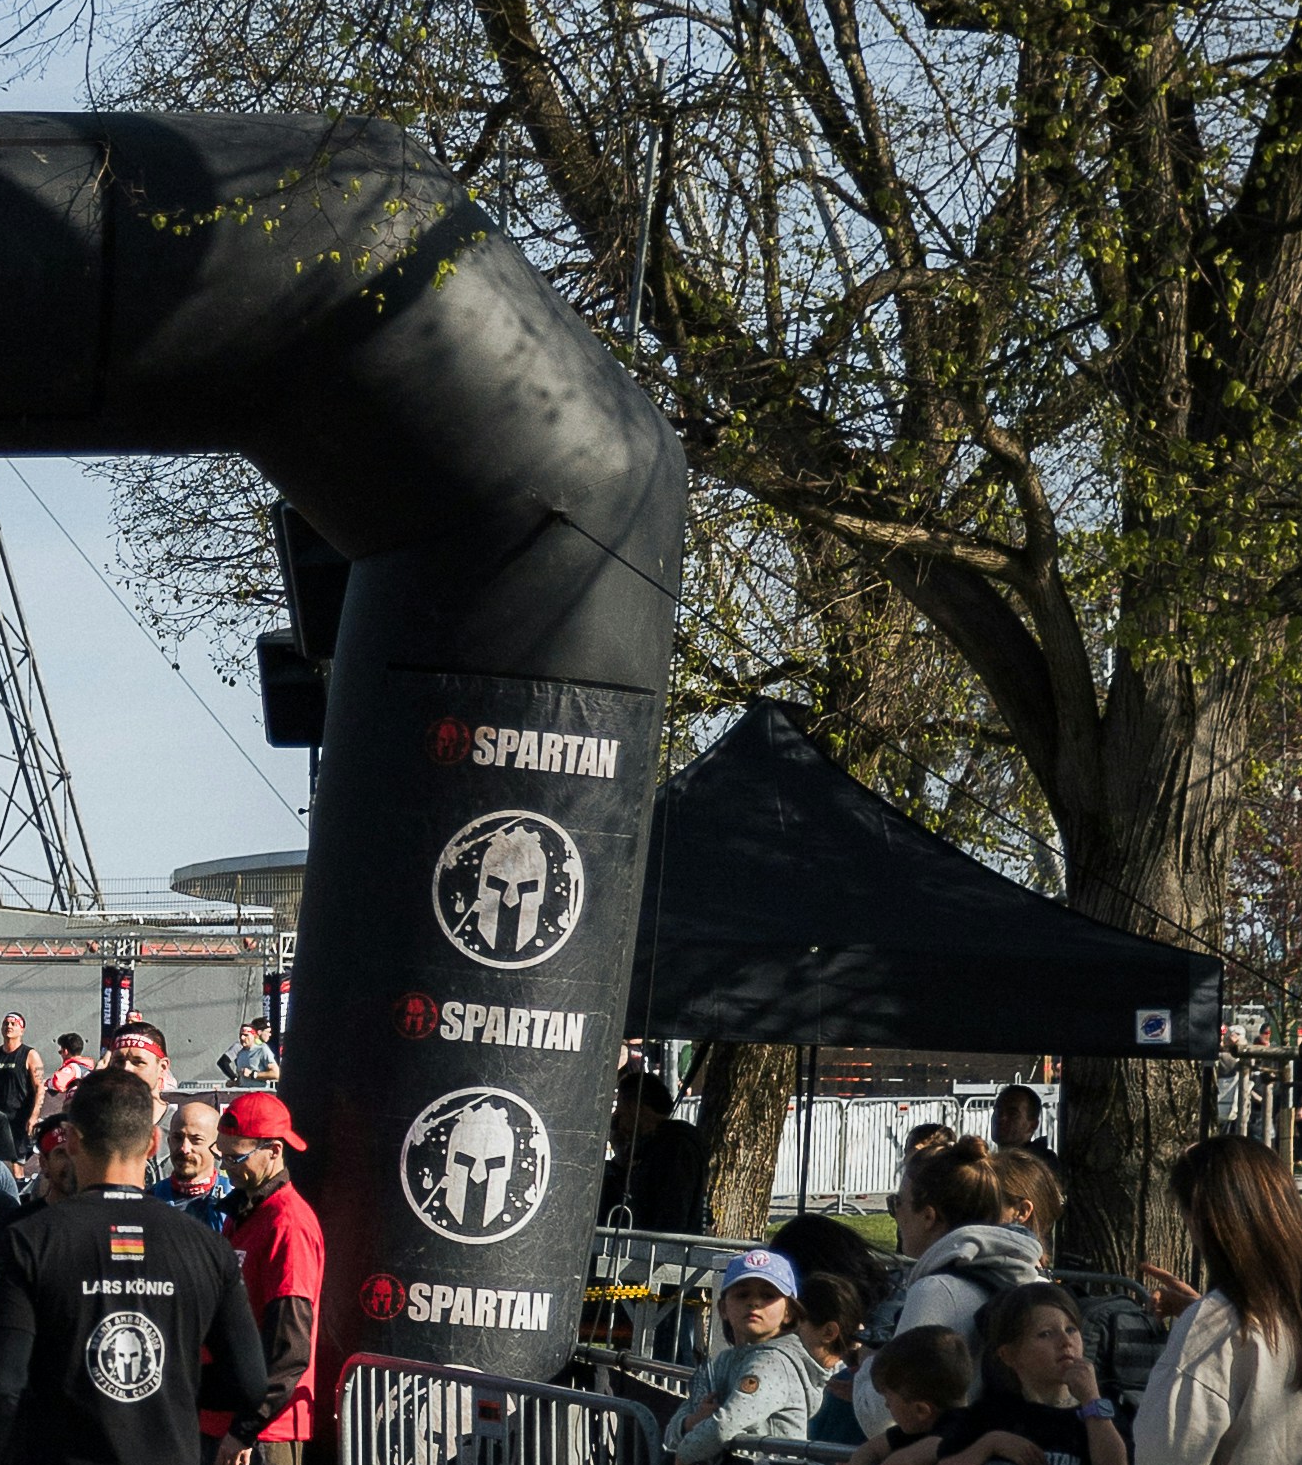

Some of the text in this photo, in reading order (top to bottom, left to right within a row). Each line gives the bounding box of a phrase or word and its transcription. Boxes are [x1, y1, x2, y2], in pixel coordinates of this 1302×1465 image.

[472, 726, 618, 779] SPARTAN
[440, 1001, 585, 1052] SPARTAN
[82, 1278, 174, 1295] LARS KÖNIG
[408, 1282, 551, 1331] SPARTAN
